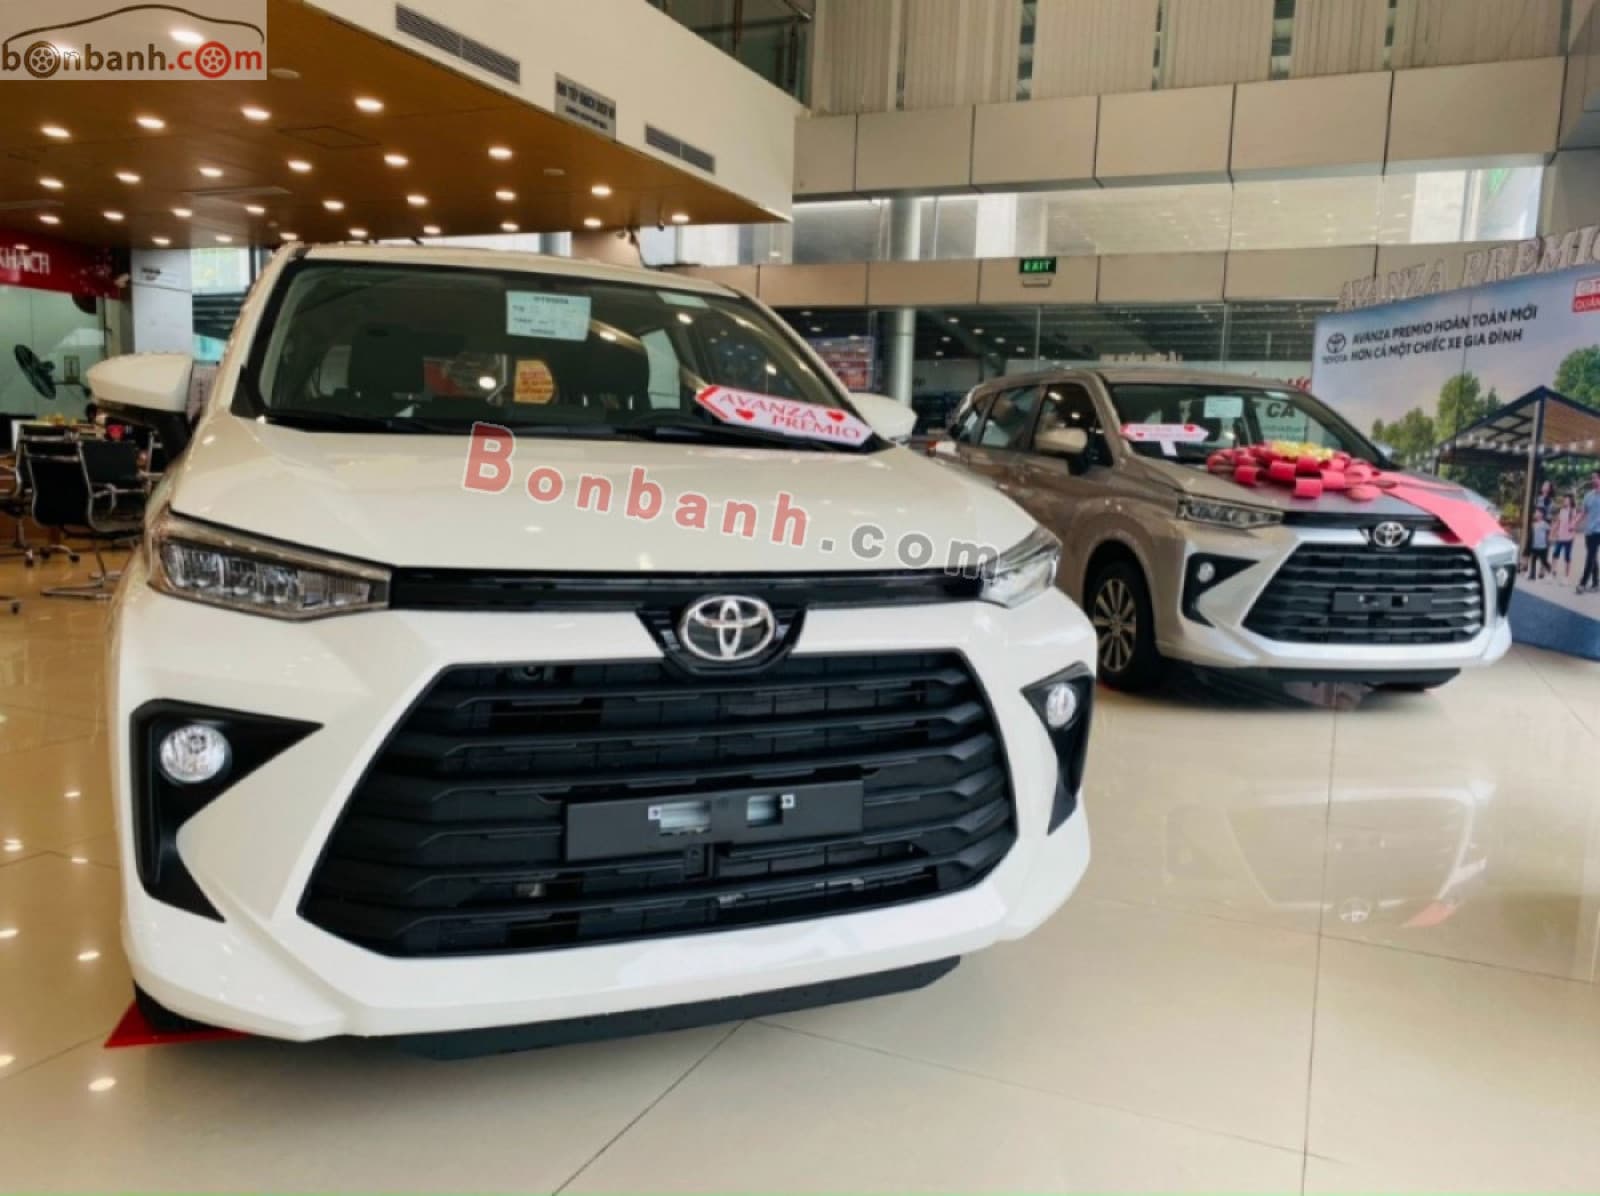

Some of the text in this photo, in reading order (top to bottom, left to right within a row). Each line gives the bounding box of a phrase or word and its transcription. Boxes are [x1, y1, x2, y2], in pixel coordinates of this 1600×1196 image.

[1023, 260, 1051, 272] EXIT
[1339, 259, 1450, 311] AVANZA
[1352, 329, 1391, 344] AVANZA
[1391, 321, 1433, 338] PREMIO
[1447, 335, 1462, 350] XE
[1463, 333, 1487, 348] GIA
[719, 393, 817, 422] AVANZA
[771, 414, 862, 440] PREMIO
